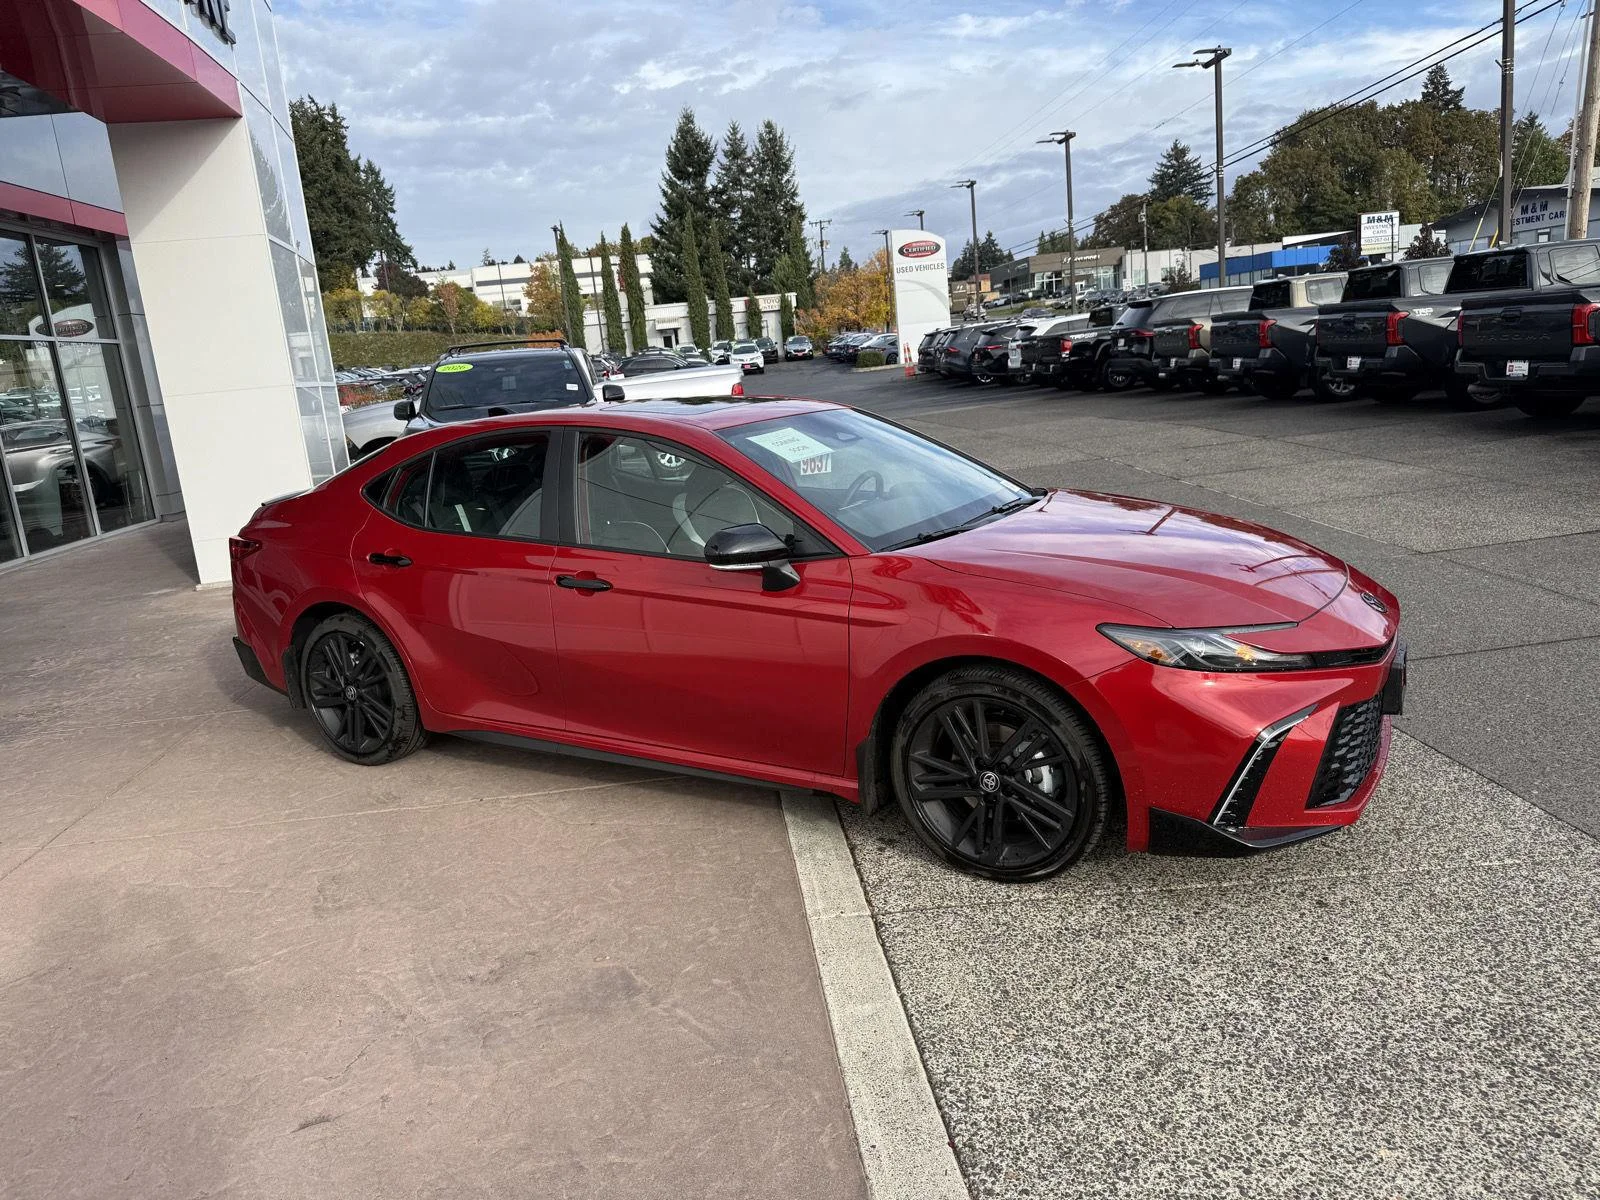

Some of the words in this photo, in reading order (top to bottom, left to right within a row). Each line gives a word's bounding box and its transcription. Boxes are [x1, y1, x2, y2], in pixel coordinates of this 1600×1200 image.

[1520, 204, 1528, 215] M
[1530, 203, 1537, 214] &
[1540, 200, 1548, 212] M
[1512, 214, 1546, 226] ESTMENT
[1548, 210, 1566, 220] CAR
[896, 266, 914, 274] USED
[914, 262, 945, 272] VEHICLES
